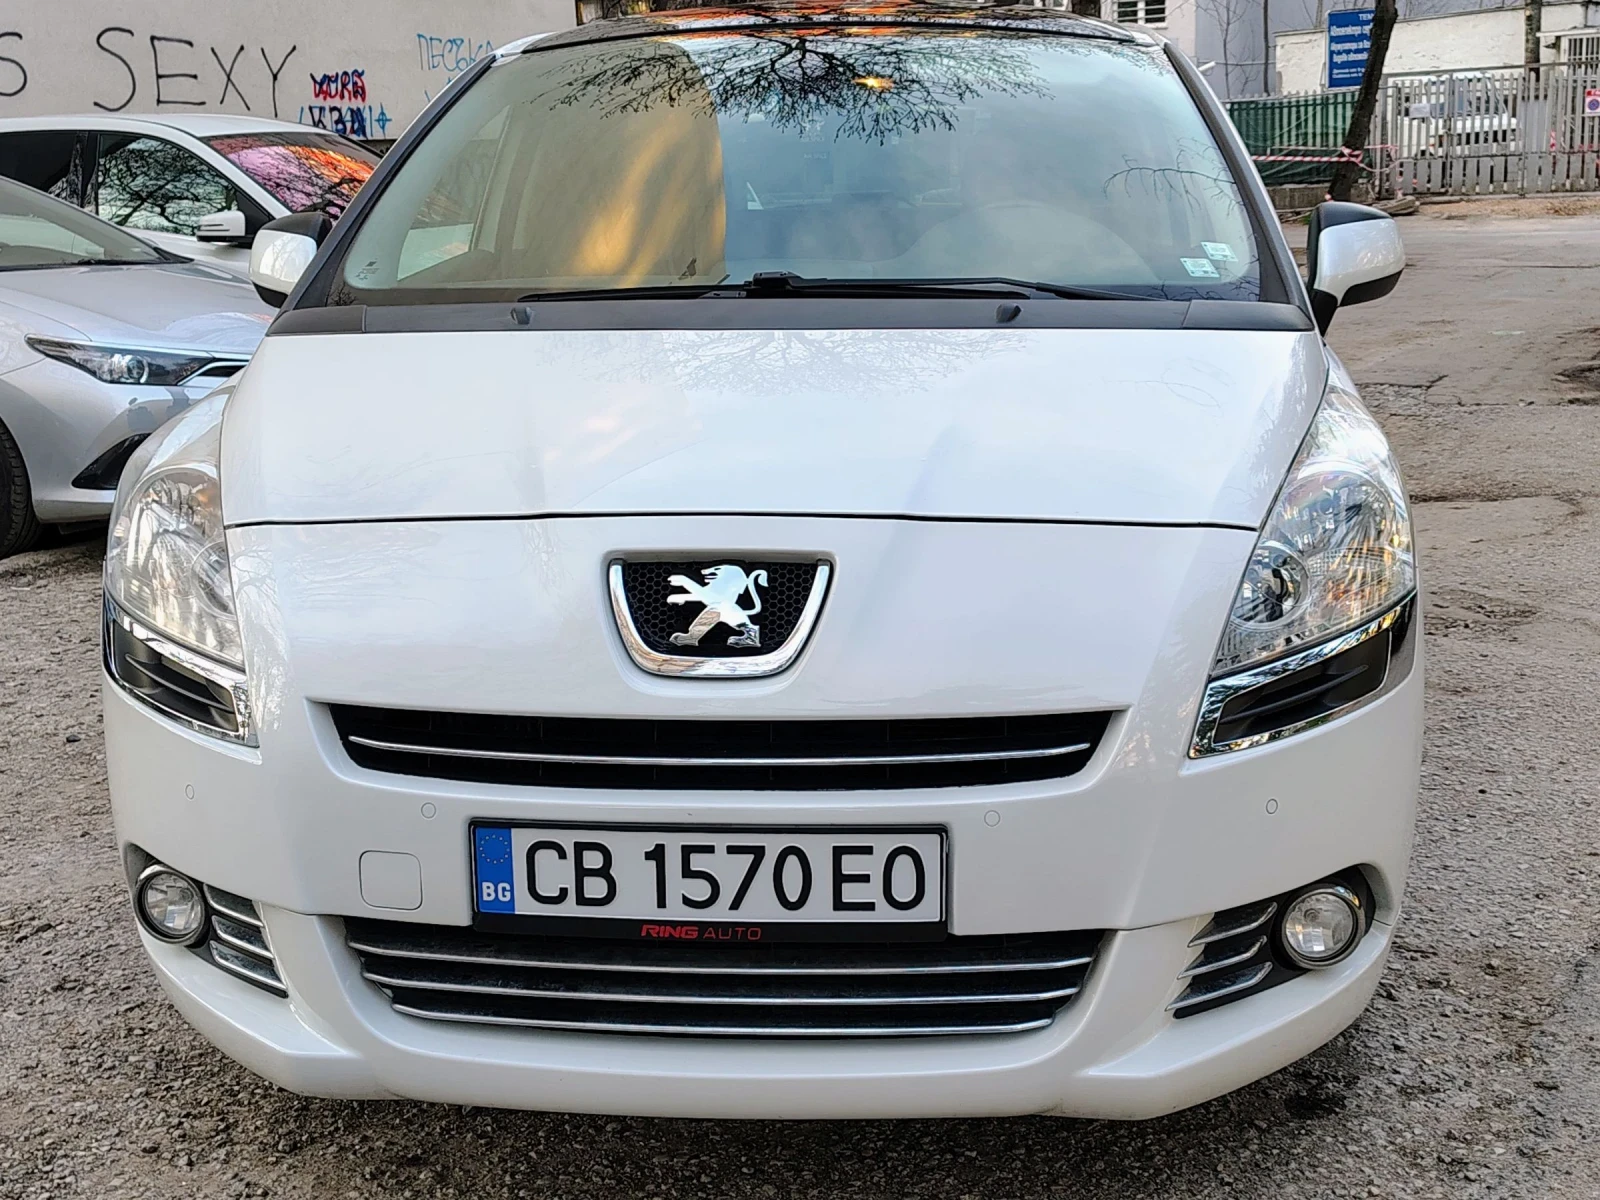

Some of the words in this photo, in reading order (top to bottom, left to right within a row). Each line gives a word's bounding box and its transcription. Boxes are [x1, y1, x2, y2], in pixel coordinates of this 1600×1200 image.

[93, 27, 296, 118] SEXY
[481, 881, 511, 902] BG
[525, 839, 617, 906] CB
[644, 843, 812, 911] 1570
[832, 845, 926, 911] EO
[641, 924, 699, 940] RING
[703, 927, 762, 940] AUTO
